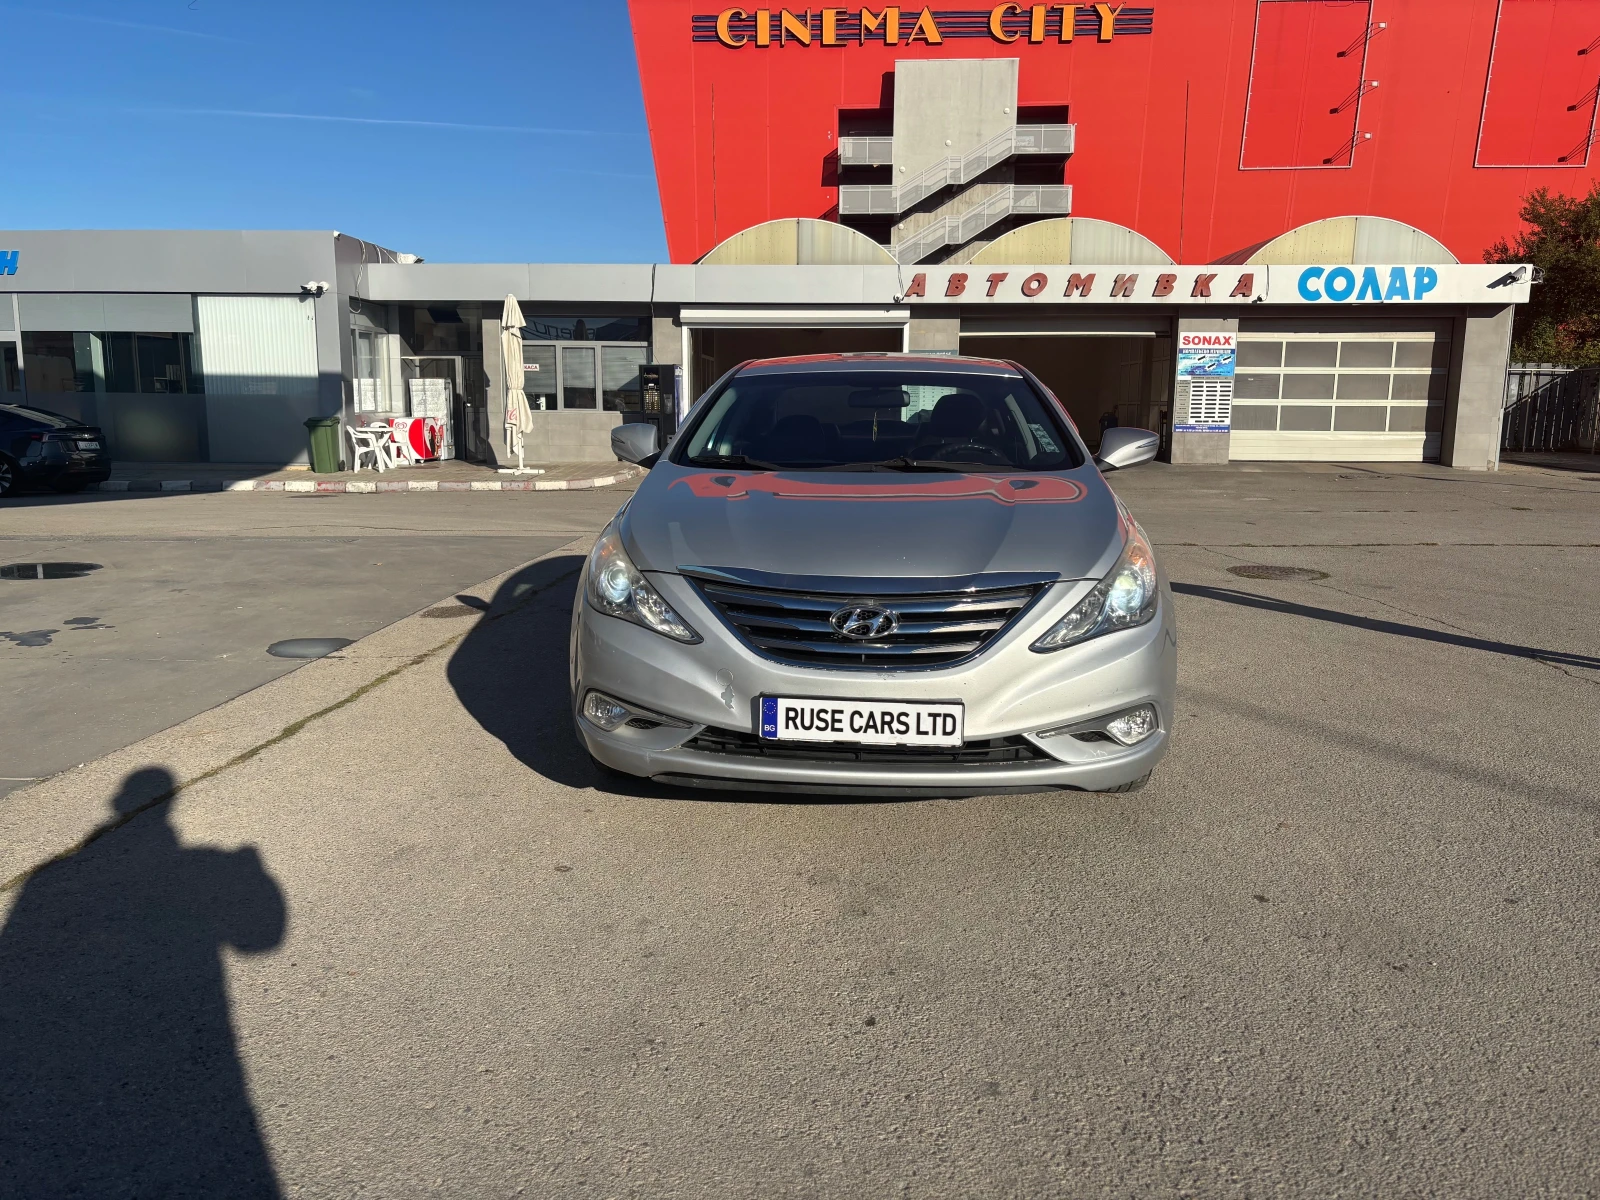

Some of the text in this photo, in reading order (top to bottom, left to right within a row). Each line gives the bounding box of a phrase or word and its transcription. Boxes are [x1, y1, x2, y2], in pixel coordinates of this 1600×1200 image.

[715, 2, 1126, 47] CINEMA CITY
[904, 273, 1255, 298] АВТОМИВКА
[1297, 266, 1438, 302] СОЛАР
[1182, 335, 1232, 346] SONAX
[764, 724, 776, 732] BG
[785, 707, 957, 736] RUSE CARS LTD
